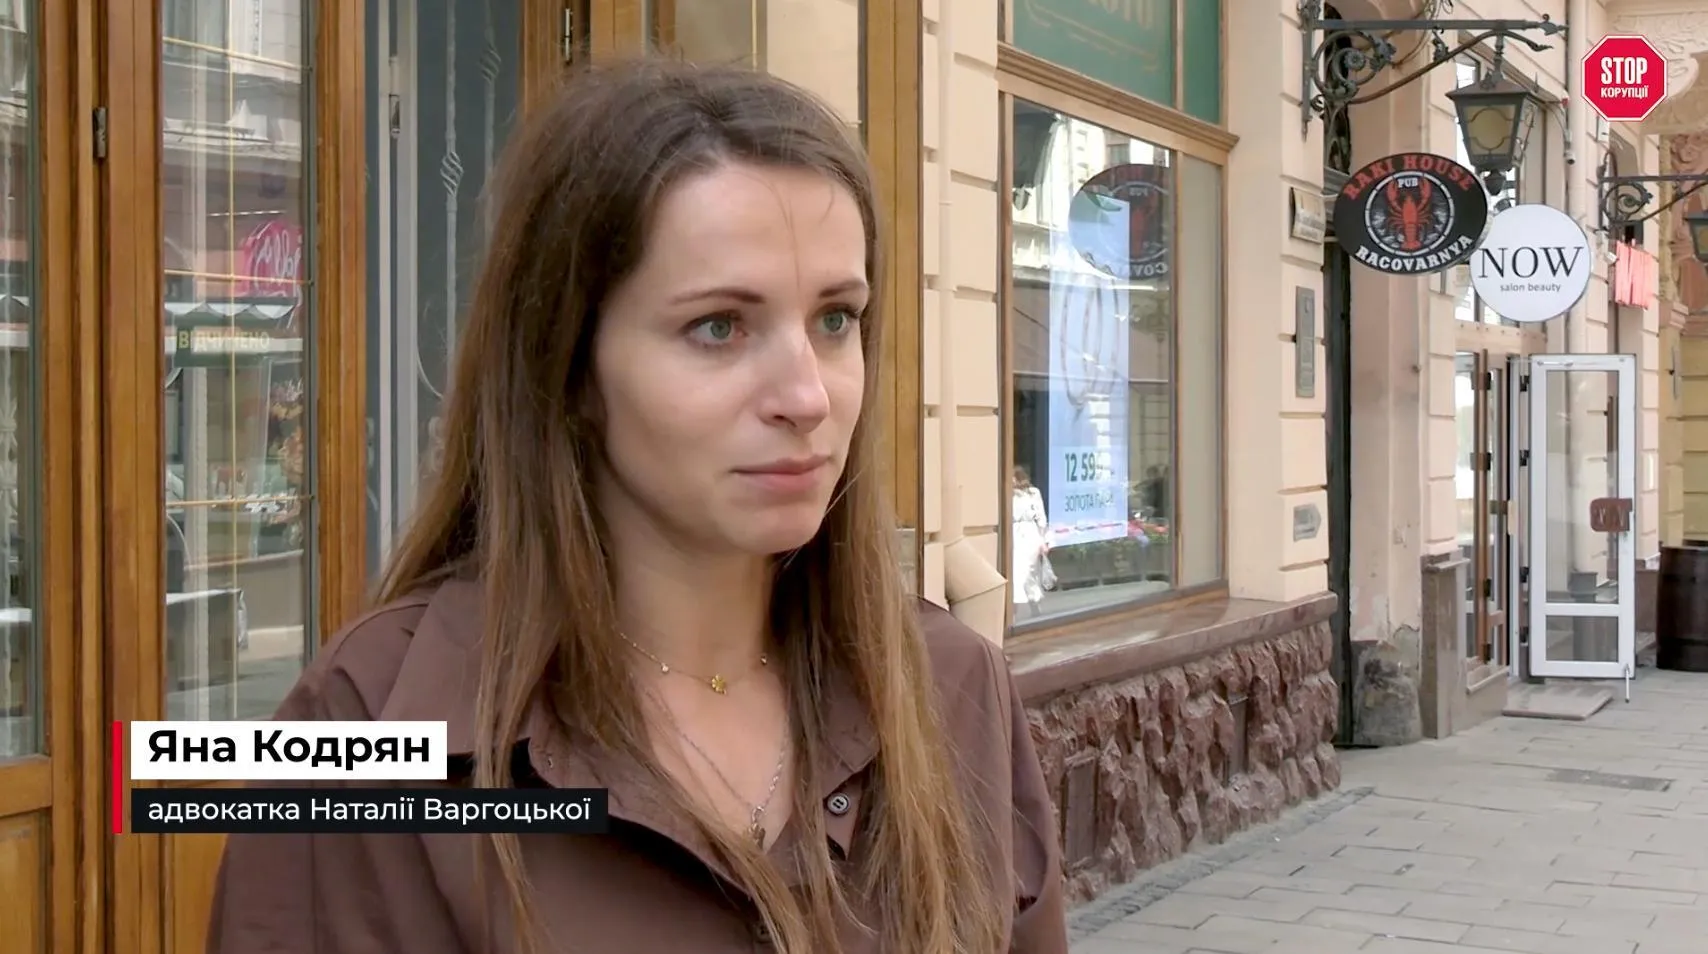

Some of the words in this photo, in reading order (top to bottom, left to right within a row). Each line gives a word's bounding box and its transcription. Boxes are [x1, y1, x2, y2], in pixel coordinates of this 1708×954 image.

[1343, 158, 1395, 199] RAKI
[1403, 154, 1475, 191] HOUSE
[1397, 177, 1419, 188] PUB
[1354, 234, 1474, 272] RACOVARNYA
[1478, 246, 1585, 278] NOW
[1500, 282, 1525, 292] salon
[1528, 282, 1561, 294] beauty
[1065, 452, 1078, 483] 12
